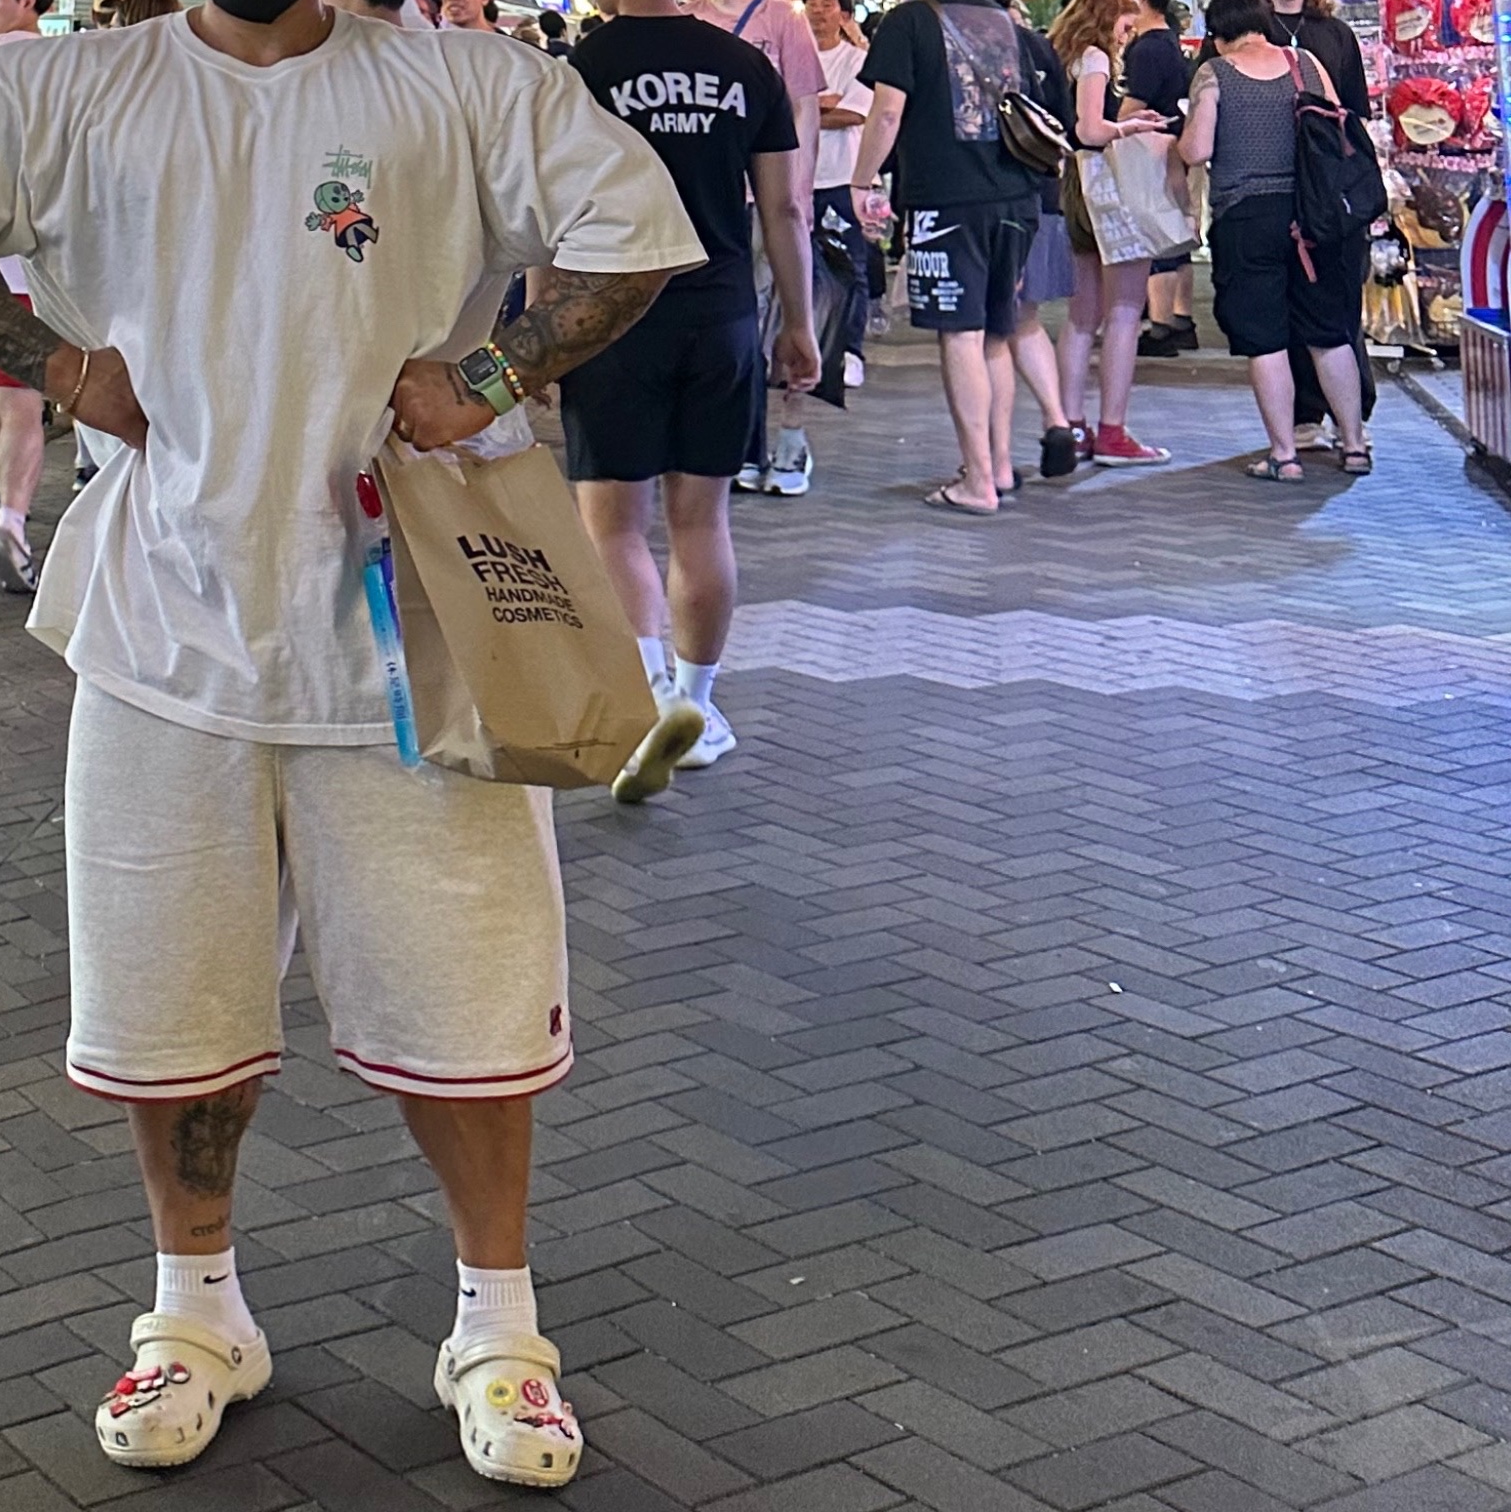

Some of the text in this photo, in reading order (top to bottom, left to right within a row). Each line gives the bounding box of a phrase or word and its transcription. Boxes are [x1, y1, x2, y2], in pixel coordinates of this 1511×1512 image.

[609, 71, 746, 118] KOREA
[650, 113, 717, 134] ARMY
[456, 533, 553, 573] LUSH
[471, 560, 569, 596] FRESH
[484, 586, 577, 613] HANDMADE
[492, 606, 584, 630] COSMETICS
